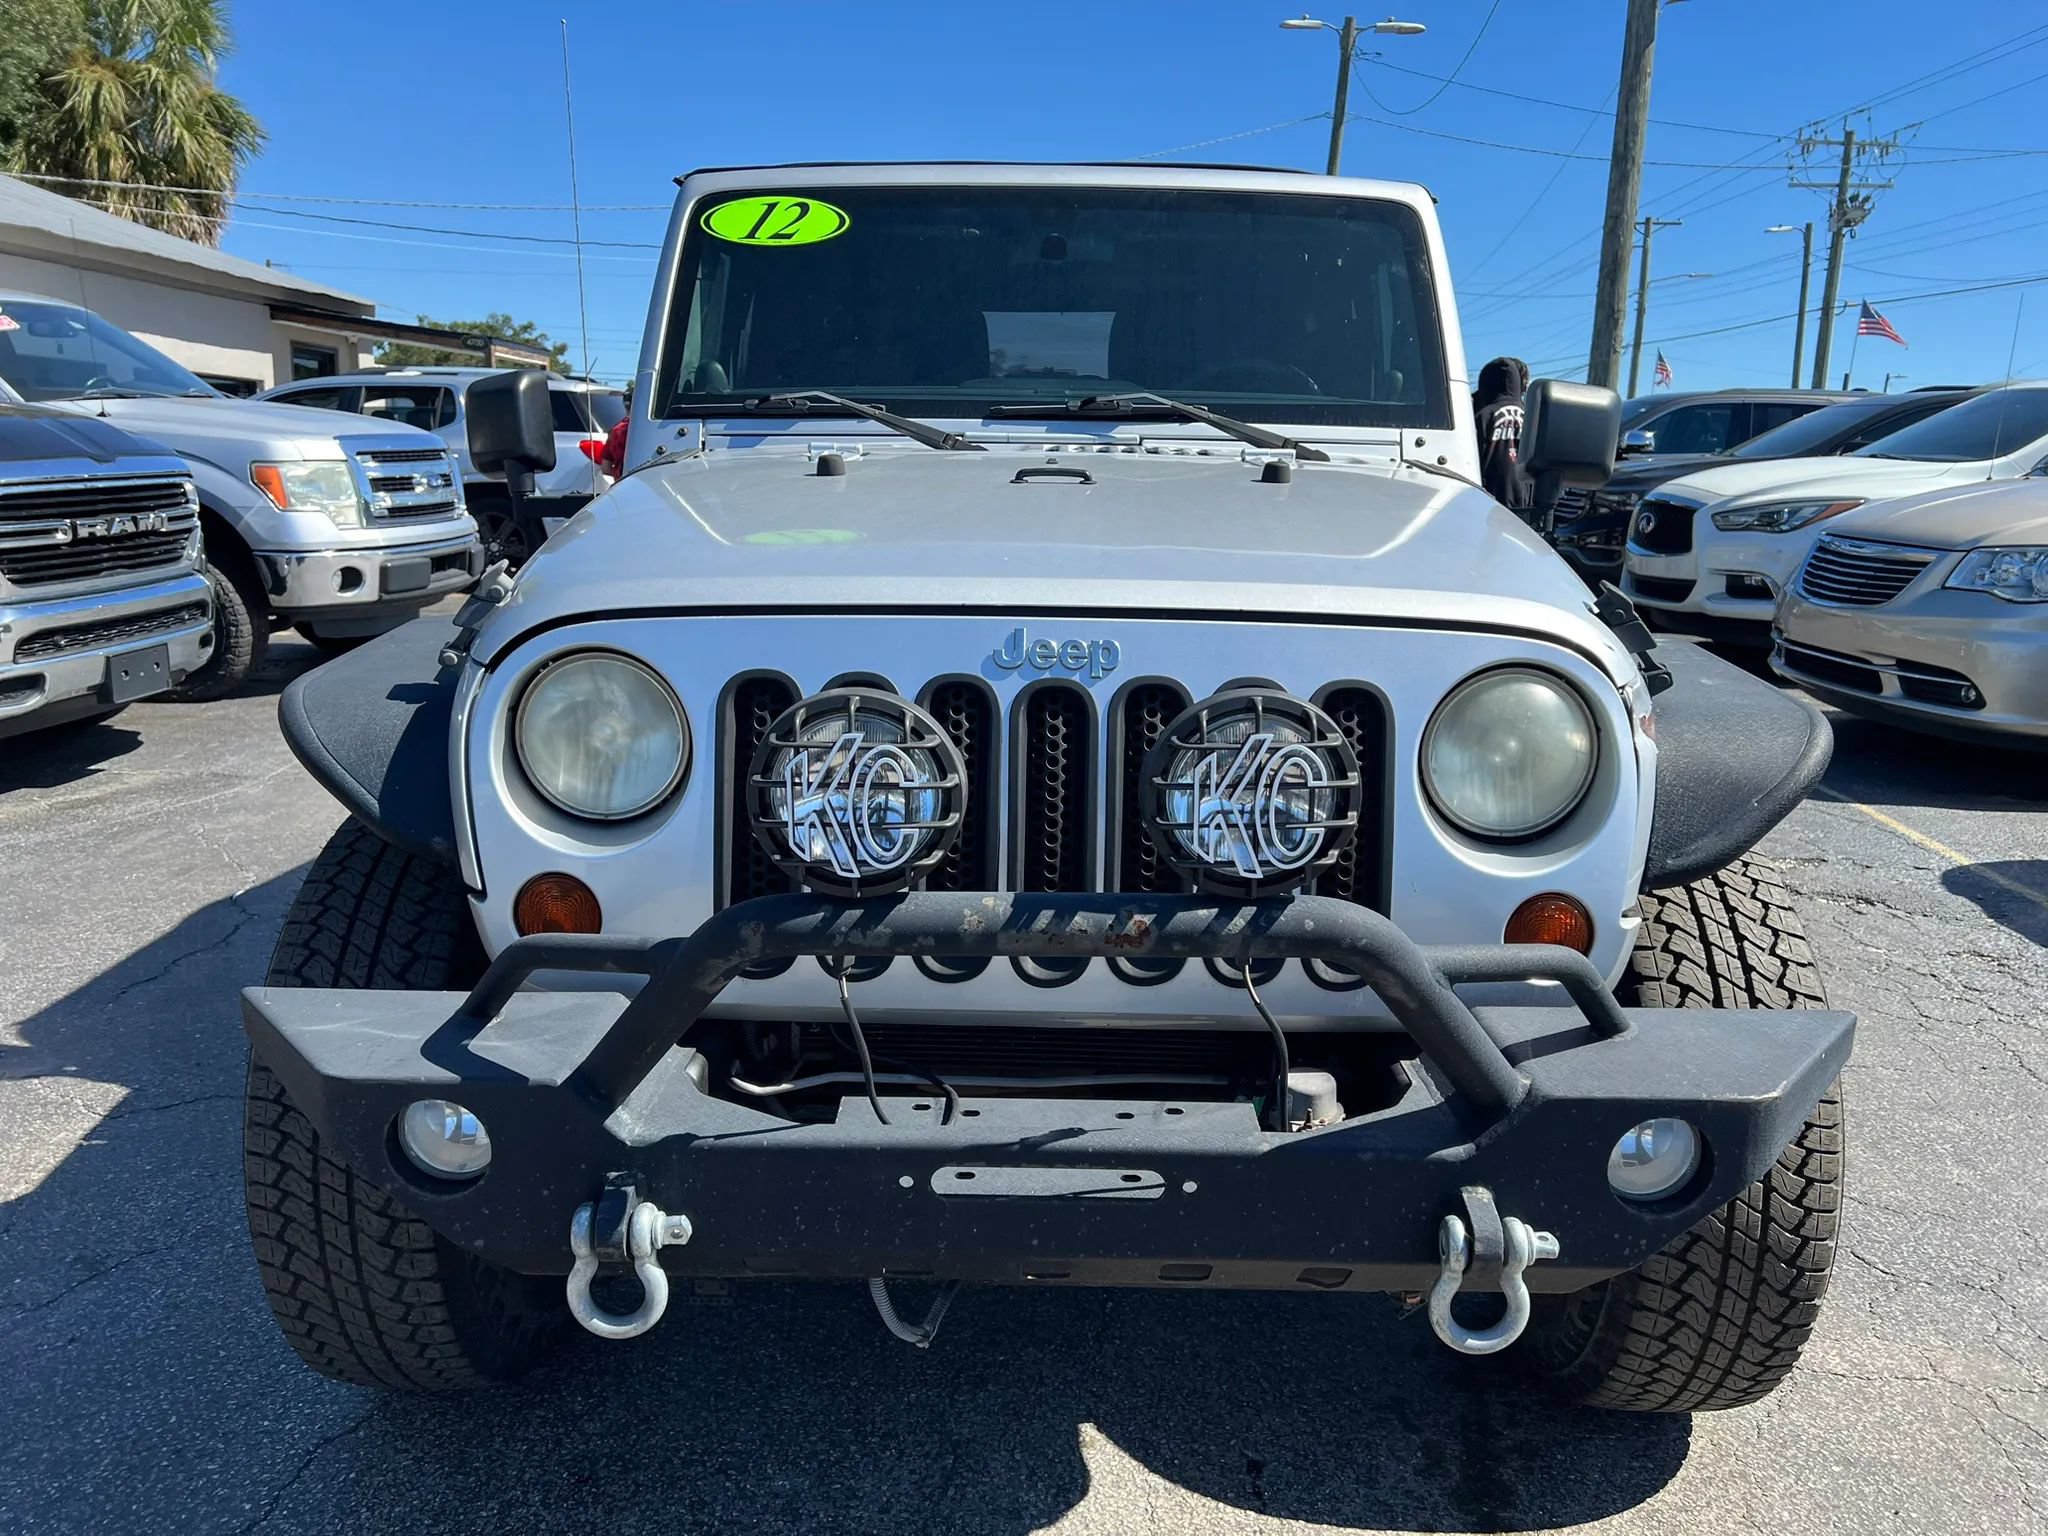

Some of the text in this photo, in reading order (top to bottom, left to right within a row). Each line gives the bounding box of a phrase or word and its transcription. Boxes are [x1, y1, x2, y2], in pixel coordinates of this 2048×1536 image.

[737, 200, 811, 240] 12
[77, 513, 168, 539] RAM
[993, 627, 1120, 679] Jeep
[785, 732, 919, 878] KC
[1193, 733, 1327, 878] KC
